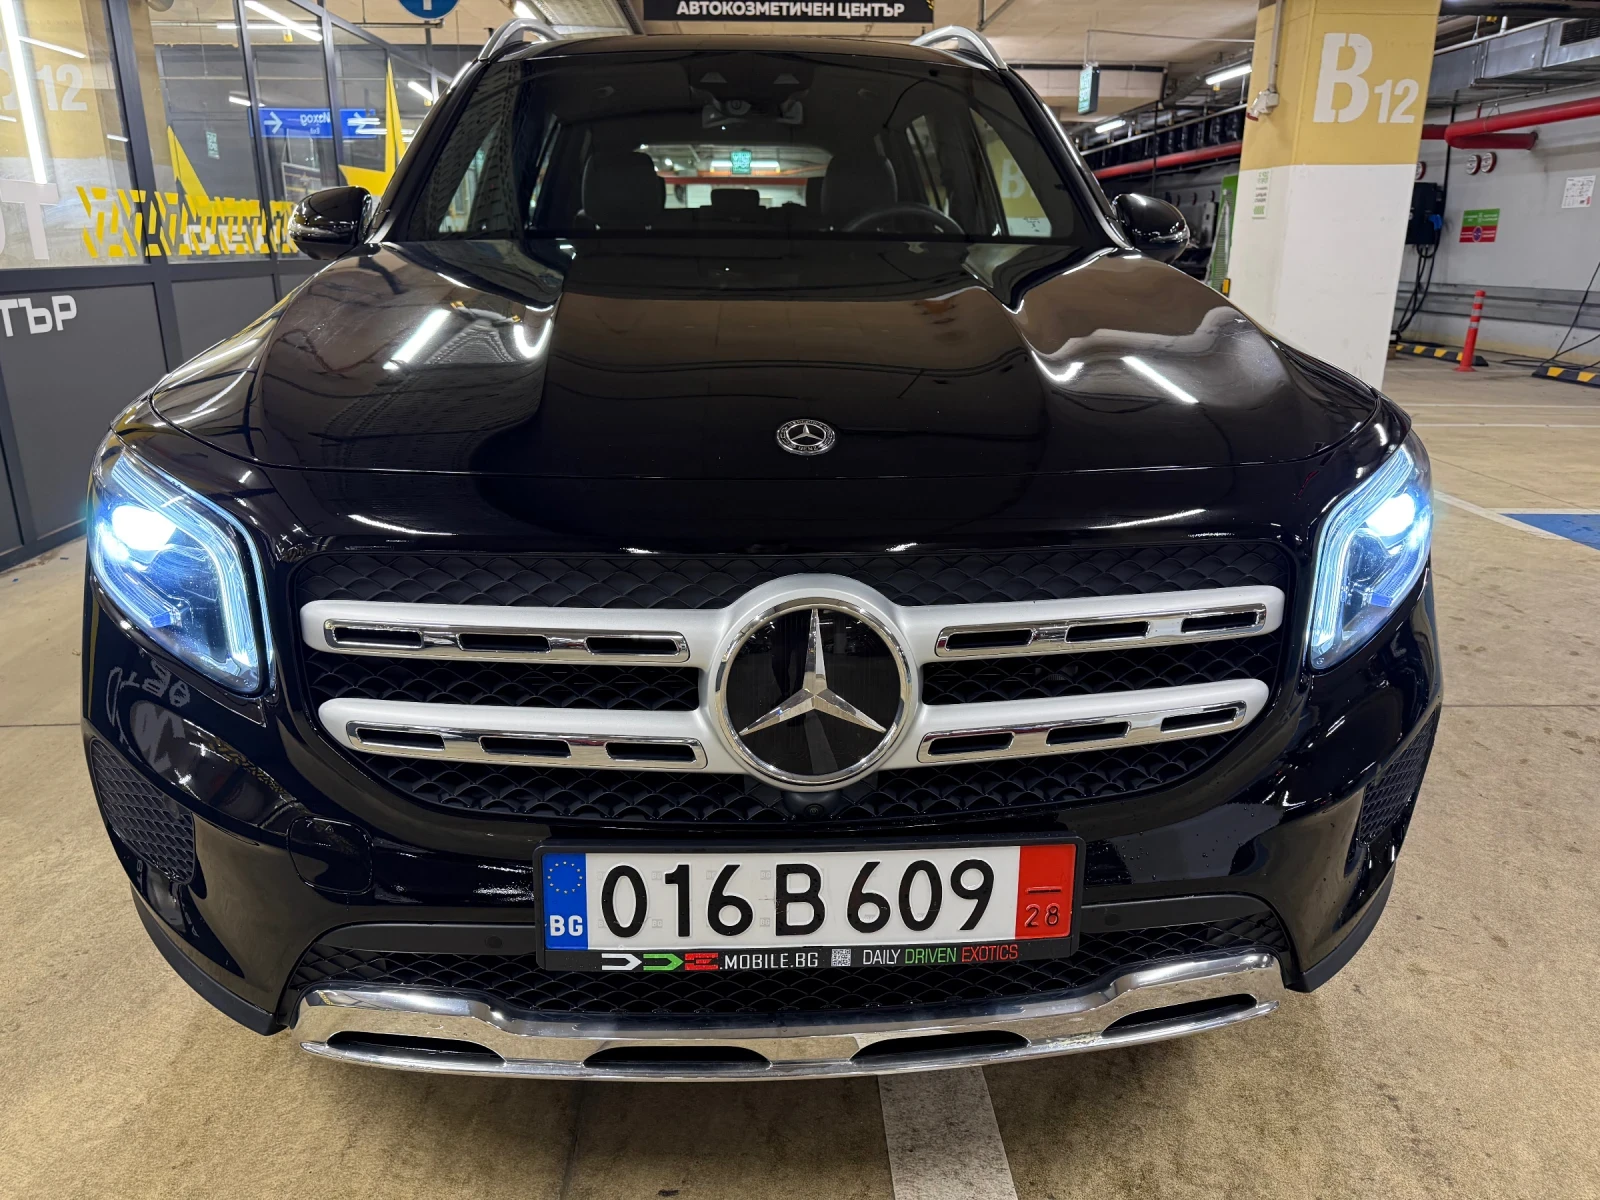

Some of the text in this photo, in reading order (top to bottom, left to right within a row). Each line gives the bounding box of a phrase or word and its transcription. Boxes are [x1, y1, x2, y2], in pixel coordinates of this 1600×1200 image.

[676, 1, 905, 19] АВТОКОЗМЕТИЧЕН ЦЕНТЪР
[601, 858, 995, 938] 016 B 609
[550, 915, 584, 937] BG
[1025, 902, 1061, 928] 28
[863, 944, 1019, 965] DAILY DRIVEN EXOTICS
